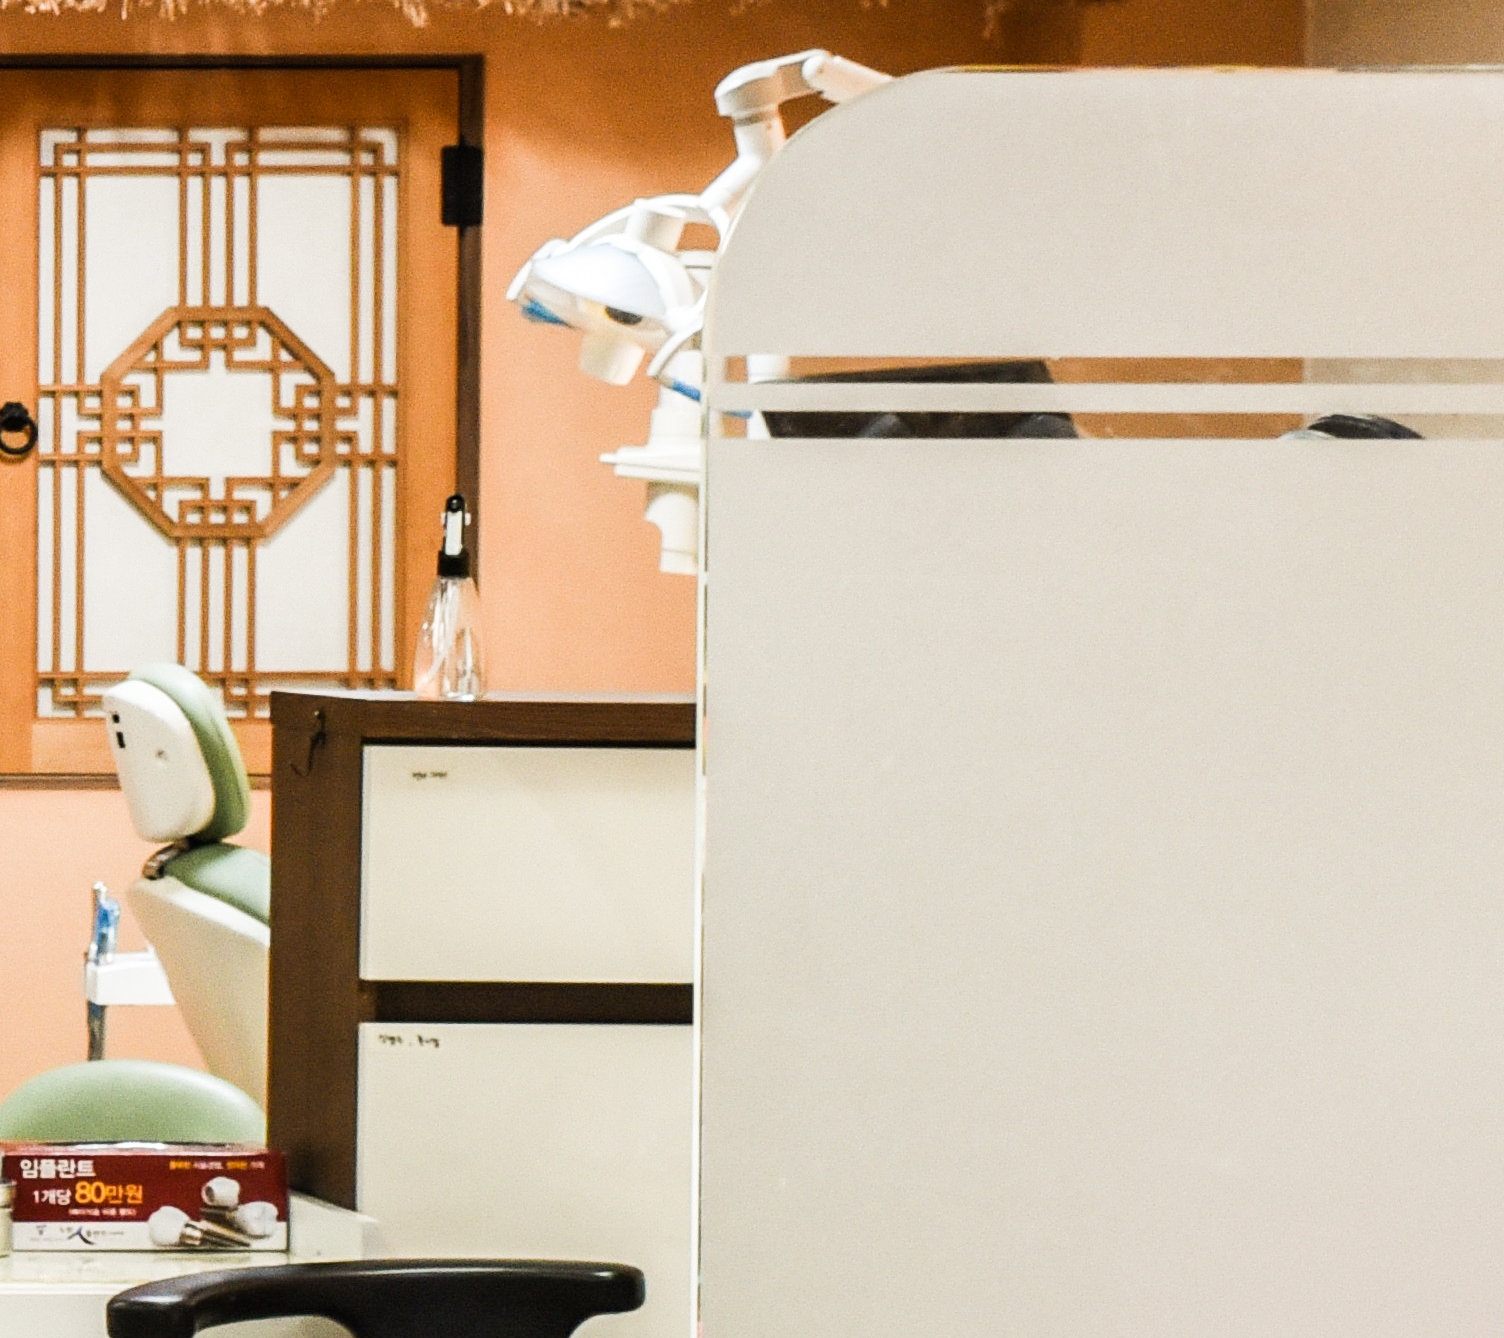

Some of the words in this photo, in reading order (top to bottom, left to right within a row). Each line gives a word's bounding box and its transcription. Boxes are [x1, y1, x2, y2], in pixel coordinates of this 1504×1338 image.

[20, 1159, 96, 1179] 임플란트
[33, 1189, 72, 1205] 1개당
[74, 1180, 143, 1204] 80만원
